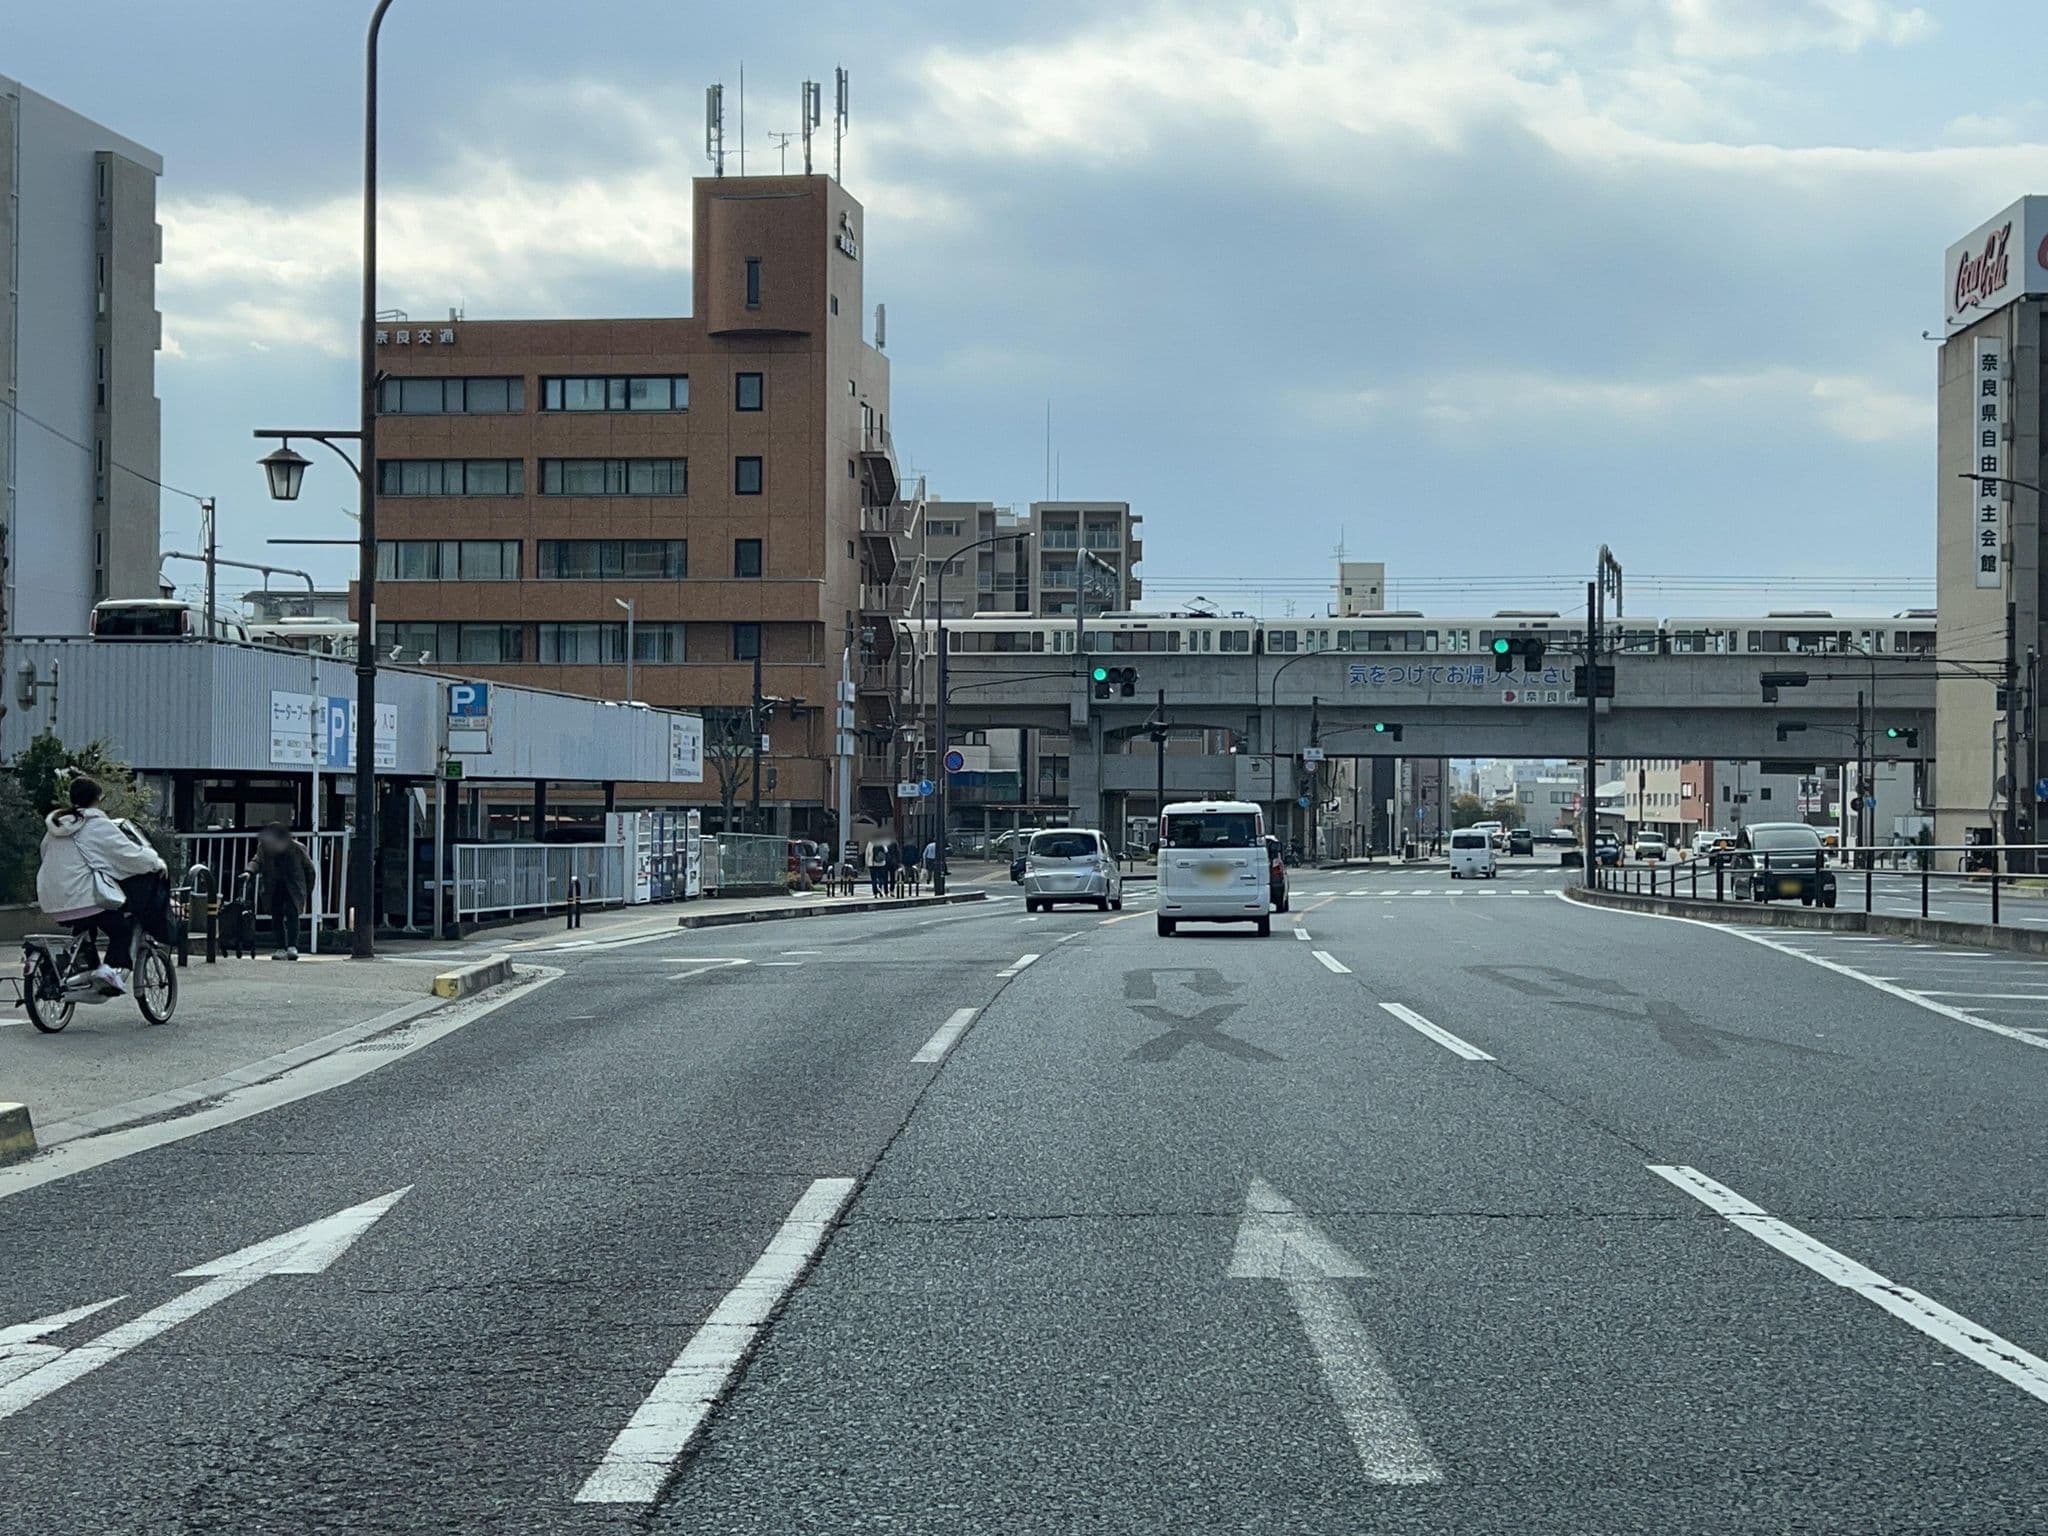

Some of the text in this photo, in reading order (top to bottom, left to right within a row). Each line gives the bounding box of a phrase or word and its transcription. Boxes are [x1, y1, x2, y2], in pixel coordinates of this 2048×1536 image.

[1980, 354, 1998, 573] 奈良県自由民主会館
[451, 686, 475, 714] P
[331, 707, 346, 756] P
